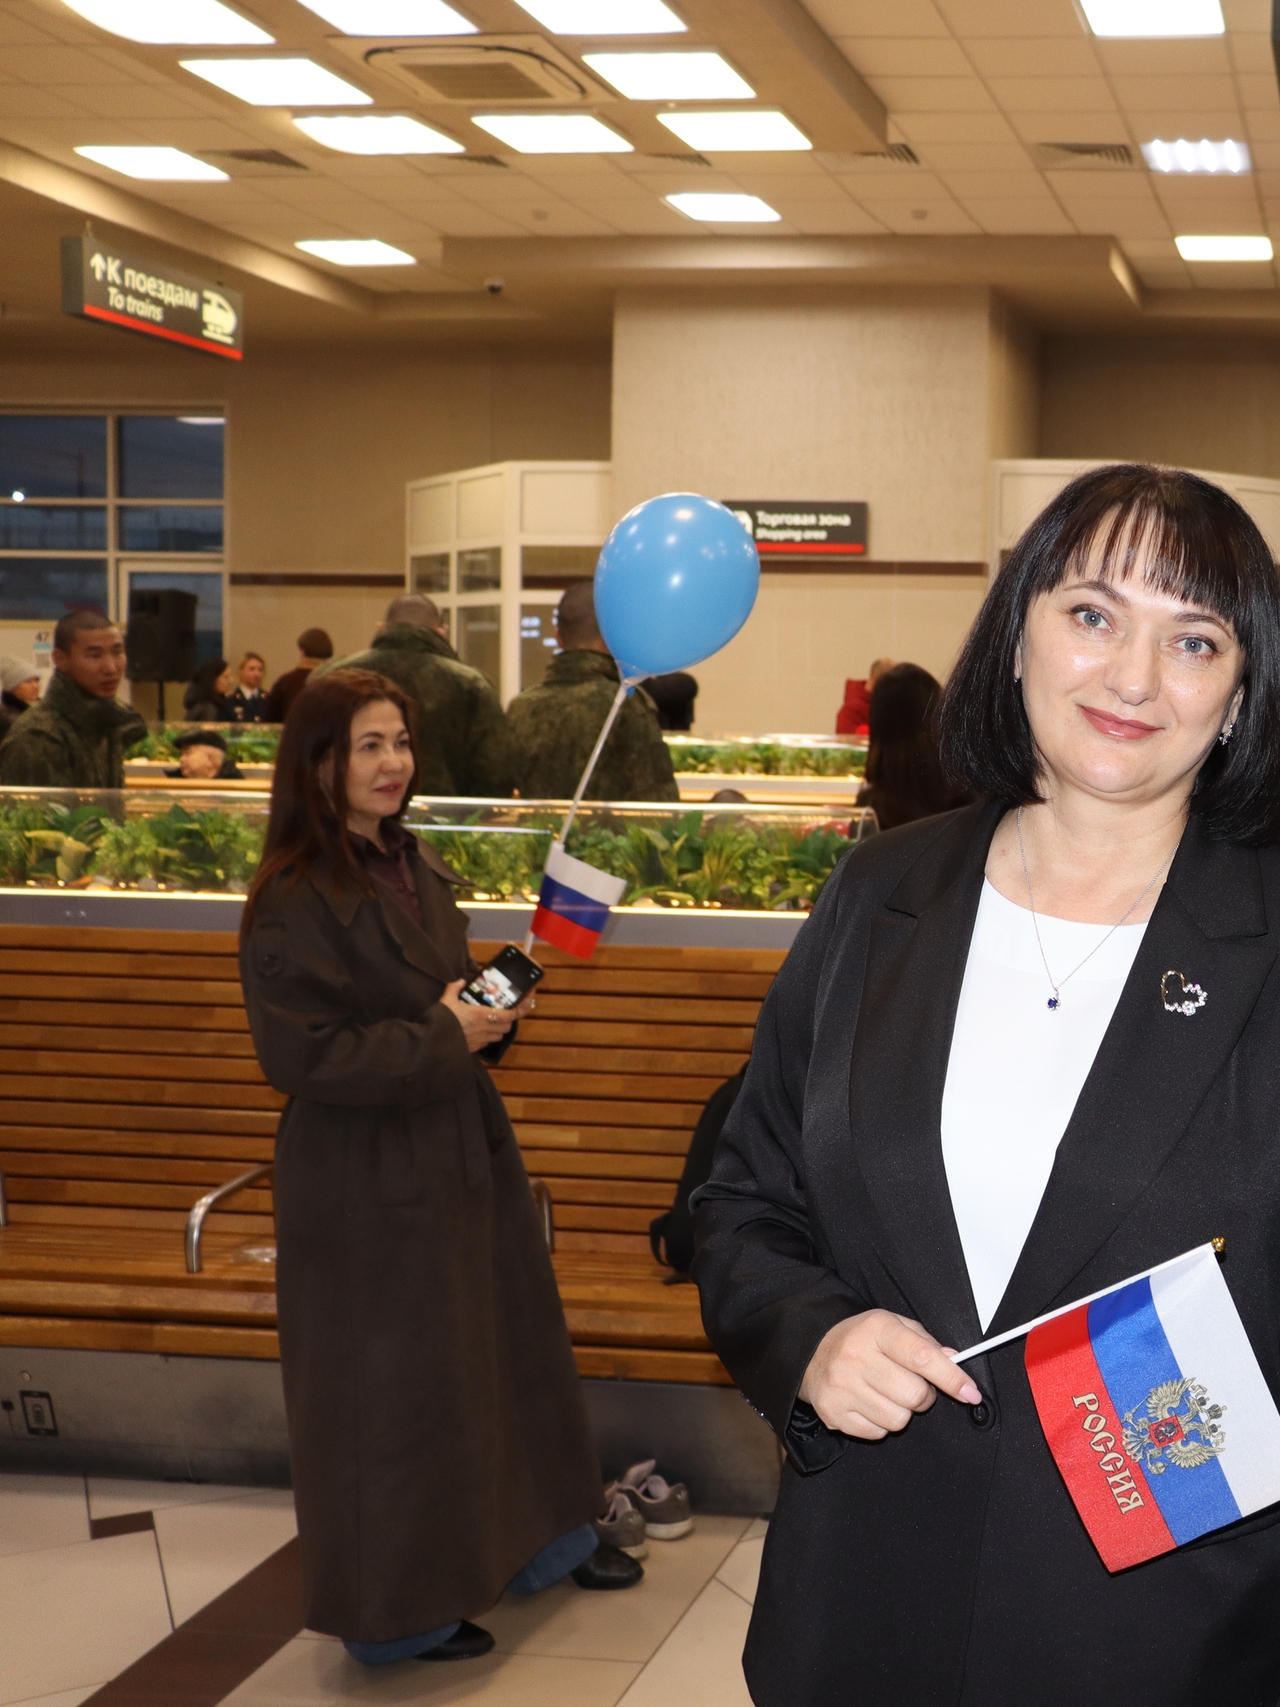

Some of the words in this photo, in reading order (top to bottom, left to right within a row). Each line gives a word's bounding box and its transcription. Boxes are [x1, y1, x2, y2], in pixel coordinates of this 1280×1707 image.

[106, 256, 123, 284] К
[124, 268, 200, 310] поездам
[107, 286, 125, 311] To
[126, 294, 164, 322] trains
[756, 510, 817, 528] Торговая
[818, 513, 851, 527] зона
[35, 631, 50, 642] 47
[1071, 1392, 1145, 1515] РОССИЯ
